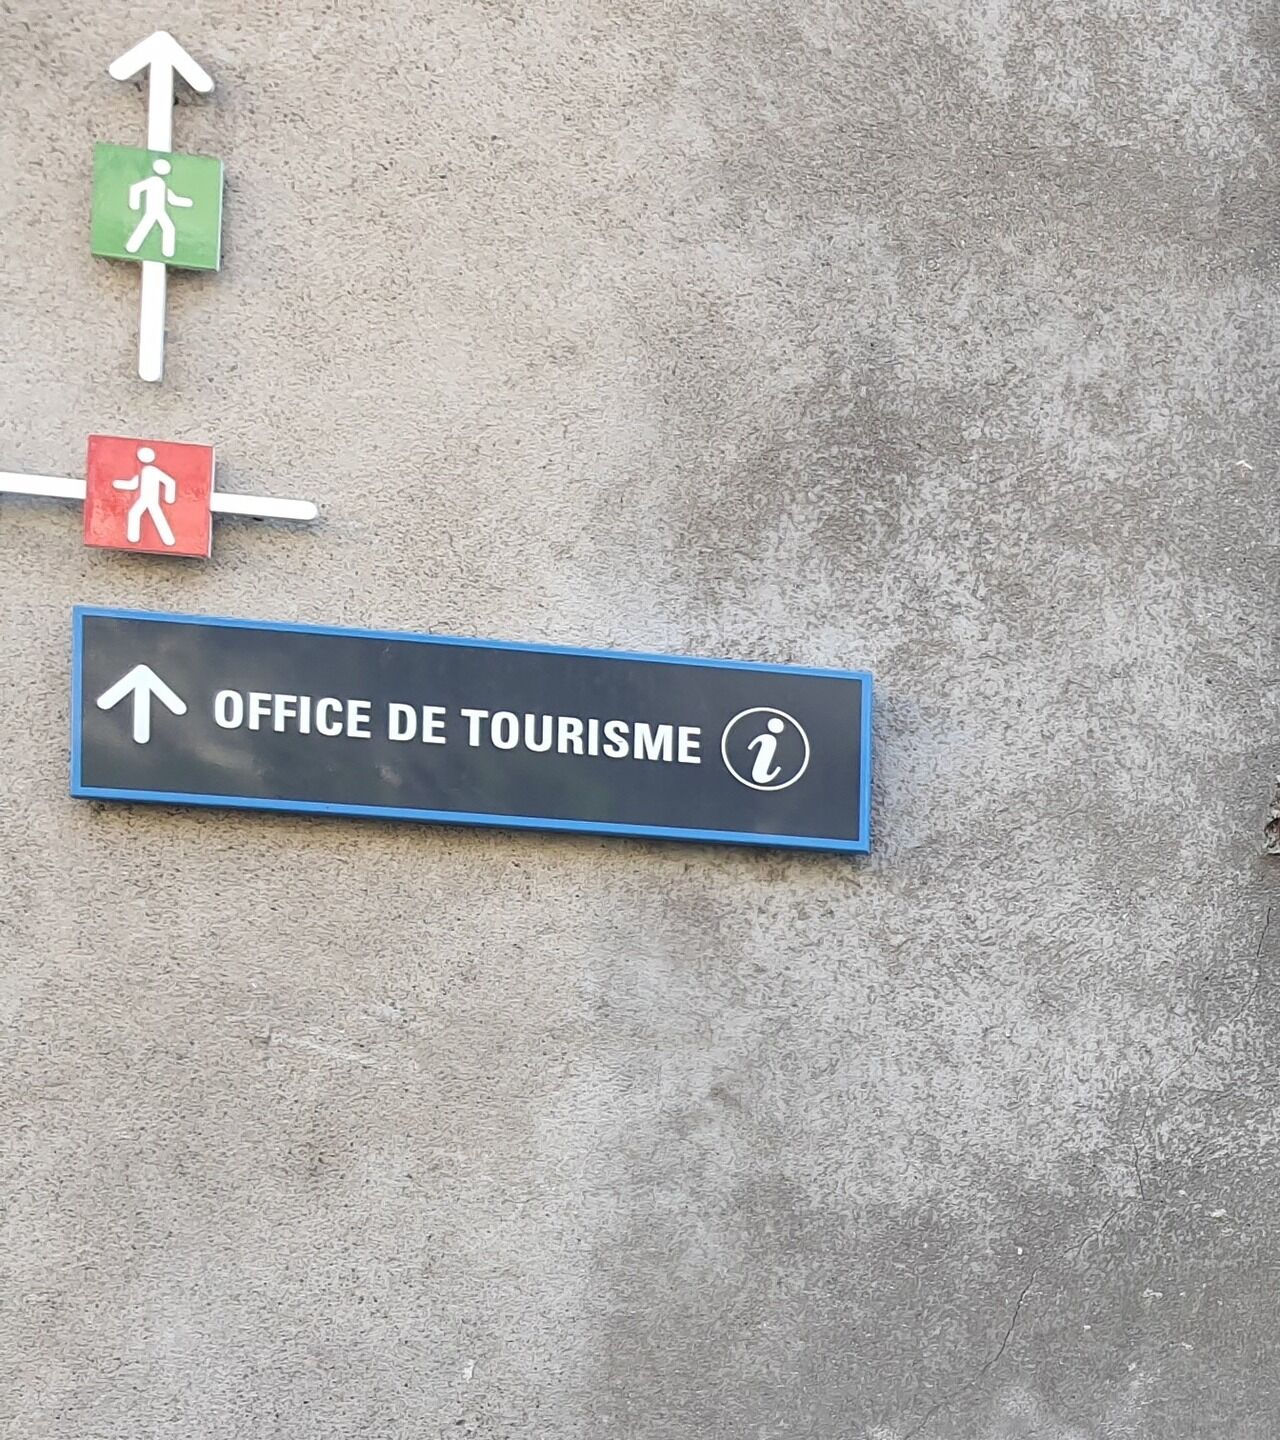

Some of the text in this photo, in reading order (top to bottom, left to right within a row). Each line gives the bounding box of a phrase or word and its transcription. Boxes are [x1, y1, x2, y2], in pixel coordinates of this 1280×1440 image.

[213, 690, 371, 738] OFFICE
[388, 703, 447, 745] DE
[461, 709, 702, 764] TOURISME
